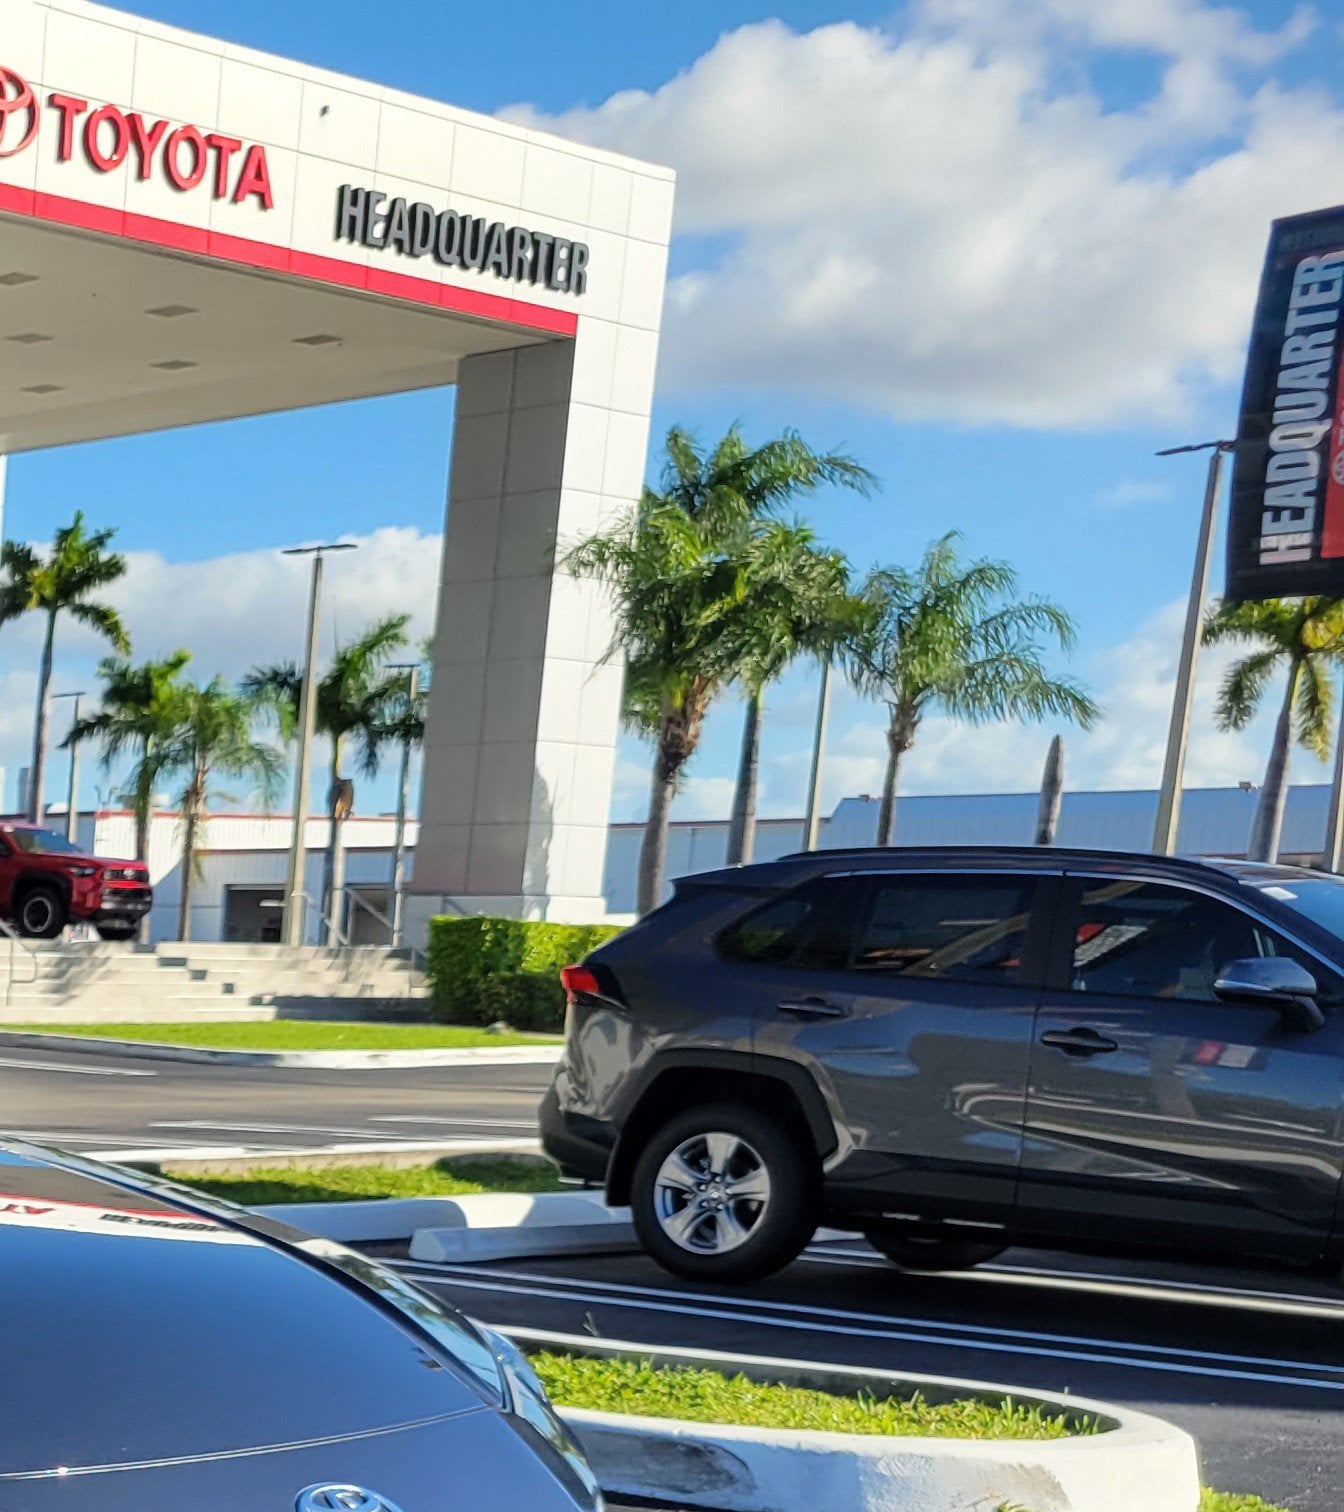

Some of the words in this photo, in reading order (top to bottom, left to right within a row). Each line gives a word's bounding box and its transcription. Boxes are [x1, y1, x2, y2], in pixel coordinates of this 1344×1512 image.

[48, 92, 274, 211] TOYOTA
[334, 184, 590, 296] HEADQUARTER
[1259, 250, 1344, 566] HEADQUARTER
